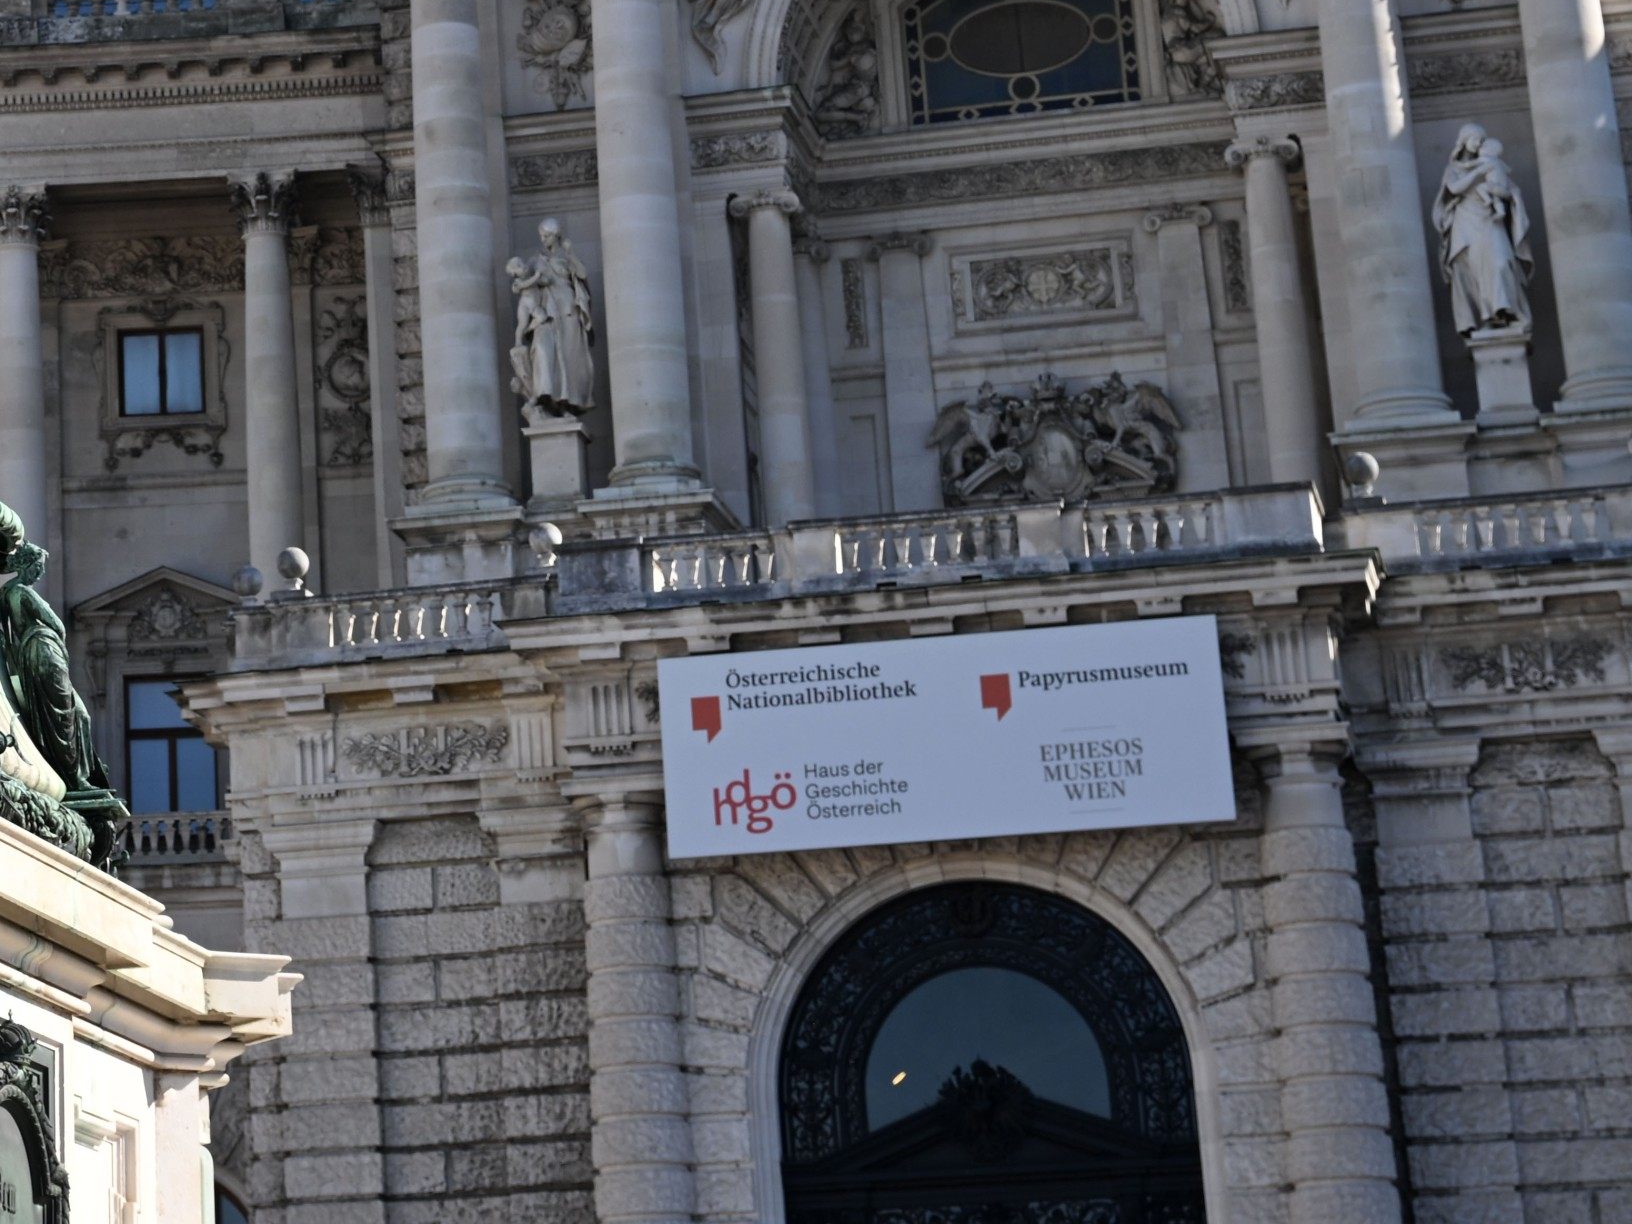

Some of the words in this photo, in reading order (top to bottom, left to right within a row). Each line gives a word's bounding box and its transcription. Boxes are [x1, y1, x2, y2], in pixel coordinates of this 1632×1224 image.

[725, 661, 881, 689] Österreichische
[1017, 661, 1190, 692] Papyrusmuseum
[726, 680, 918, 711] Nationalbibliothek
[1039, 737, 1144, 762] EPHESOS
[803, 763, 850, 780] Haus
[853, 758, 884, 776] der
[1043, 758, 1144, 783] MUSEUM
[804, 778, 910, 800] Geschichte
[1063, 780, 1127, 802] WIEN
[806, 799, 903, 820] Österreich
